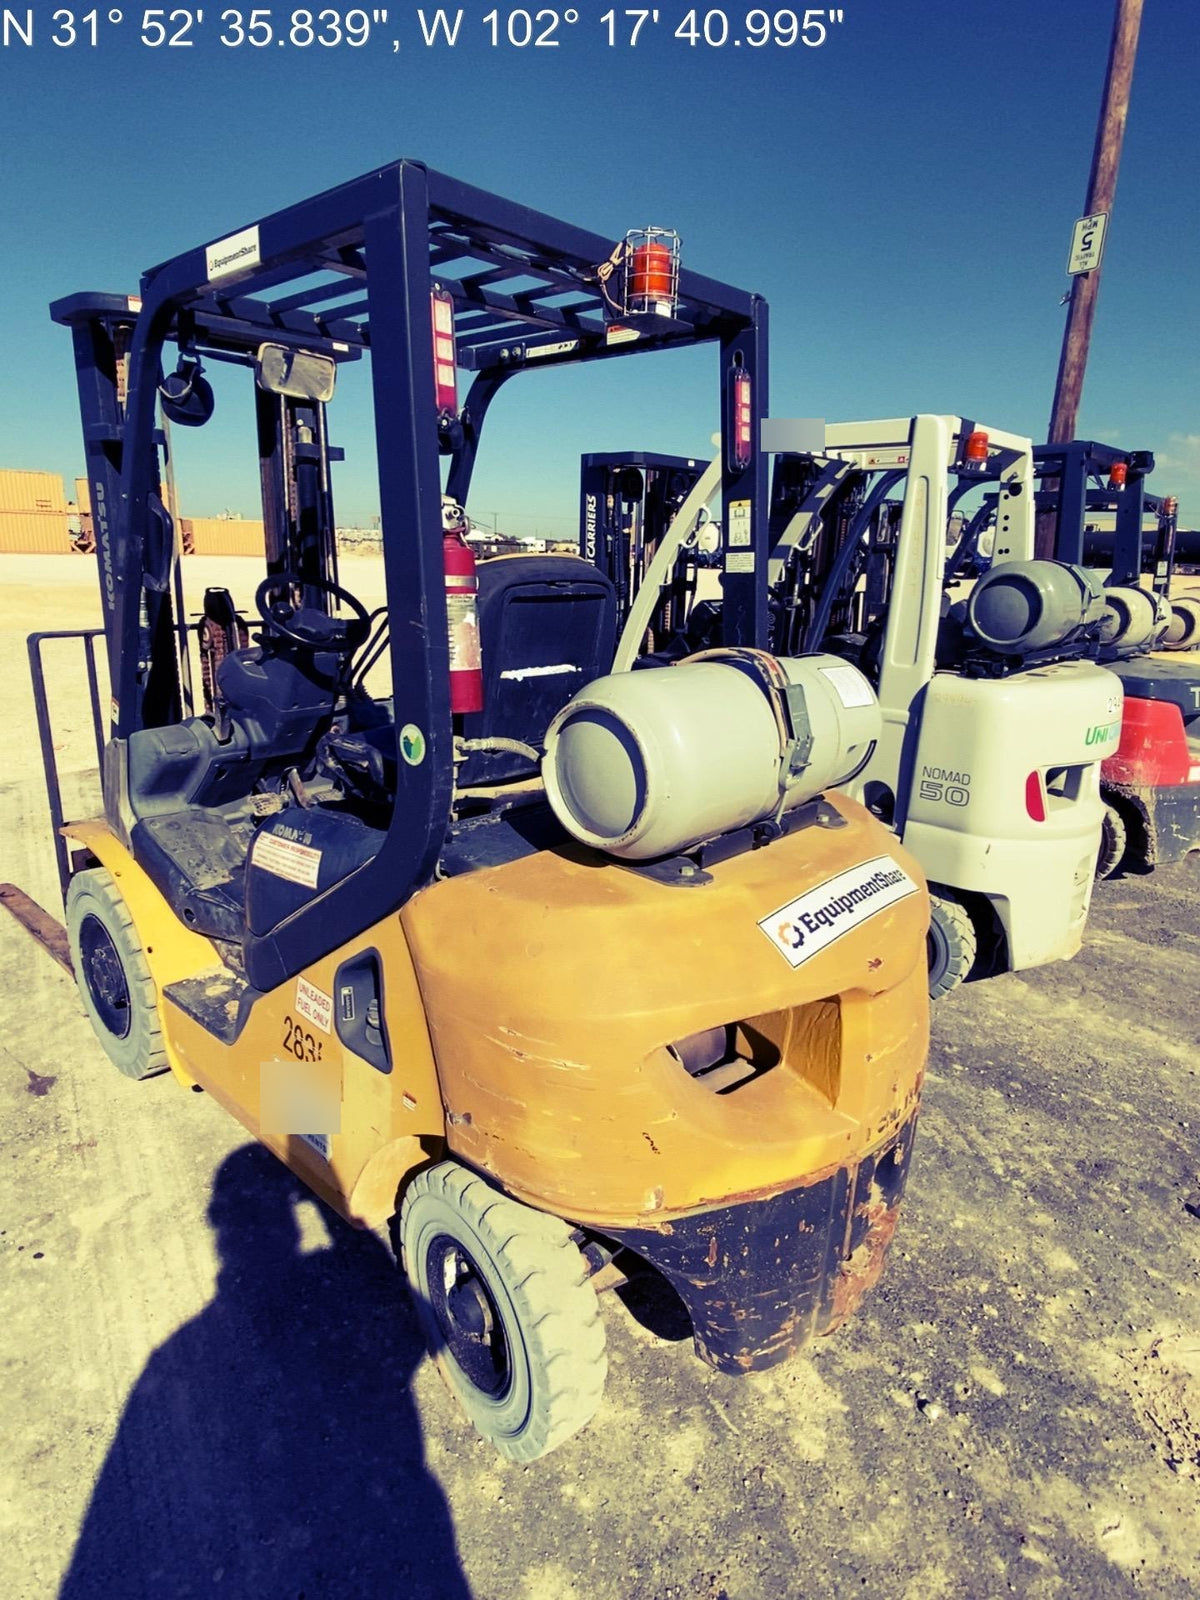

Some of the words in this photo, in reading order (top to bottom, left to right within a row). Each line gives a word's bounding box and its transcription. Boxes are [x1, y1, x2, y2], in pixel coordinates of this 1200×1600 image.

[1082, 221, 1098, 231] MPH
[1081, 231, 1094, 251] 5
[95, 481, 116, 611] KOMATSU
[922, 765, 971, 786] NOMAD
[919, 780, 971, 807] 50
[797, 868, 907, 934] EquipmentShare
[298, 982, 331, 1012] UNLEADED
[297, 997, 312, 1017] FUEL
[312, 1008, 330, 1028] ONLY
